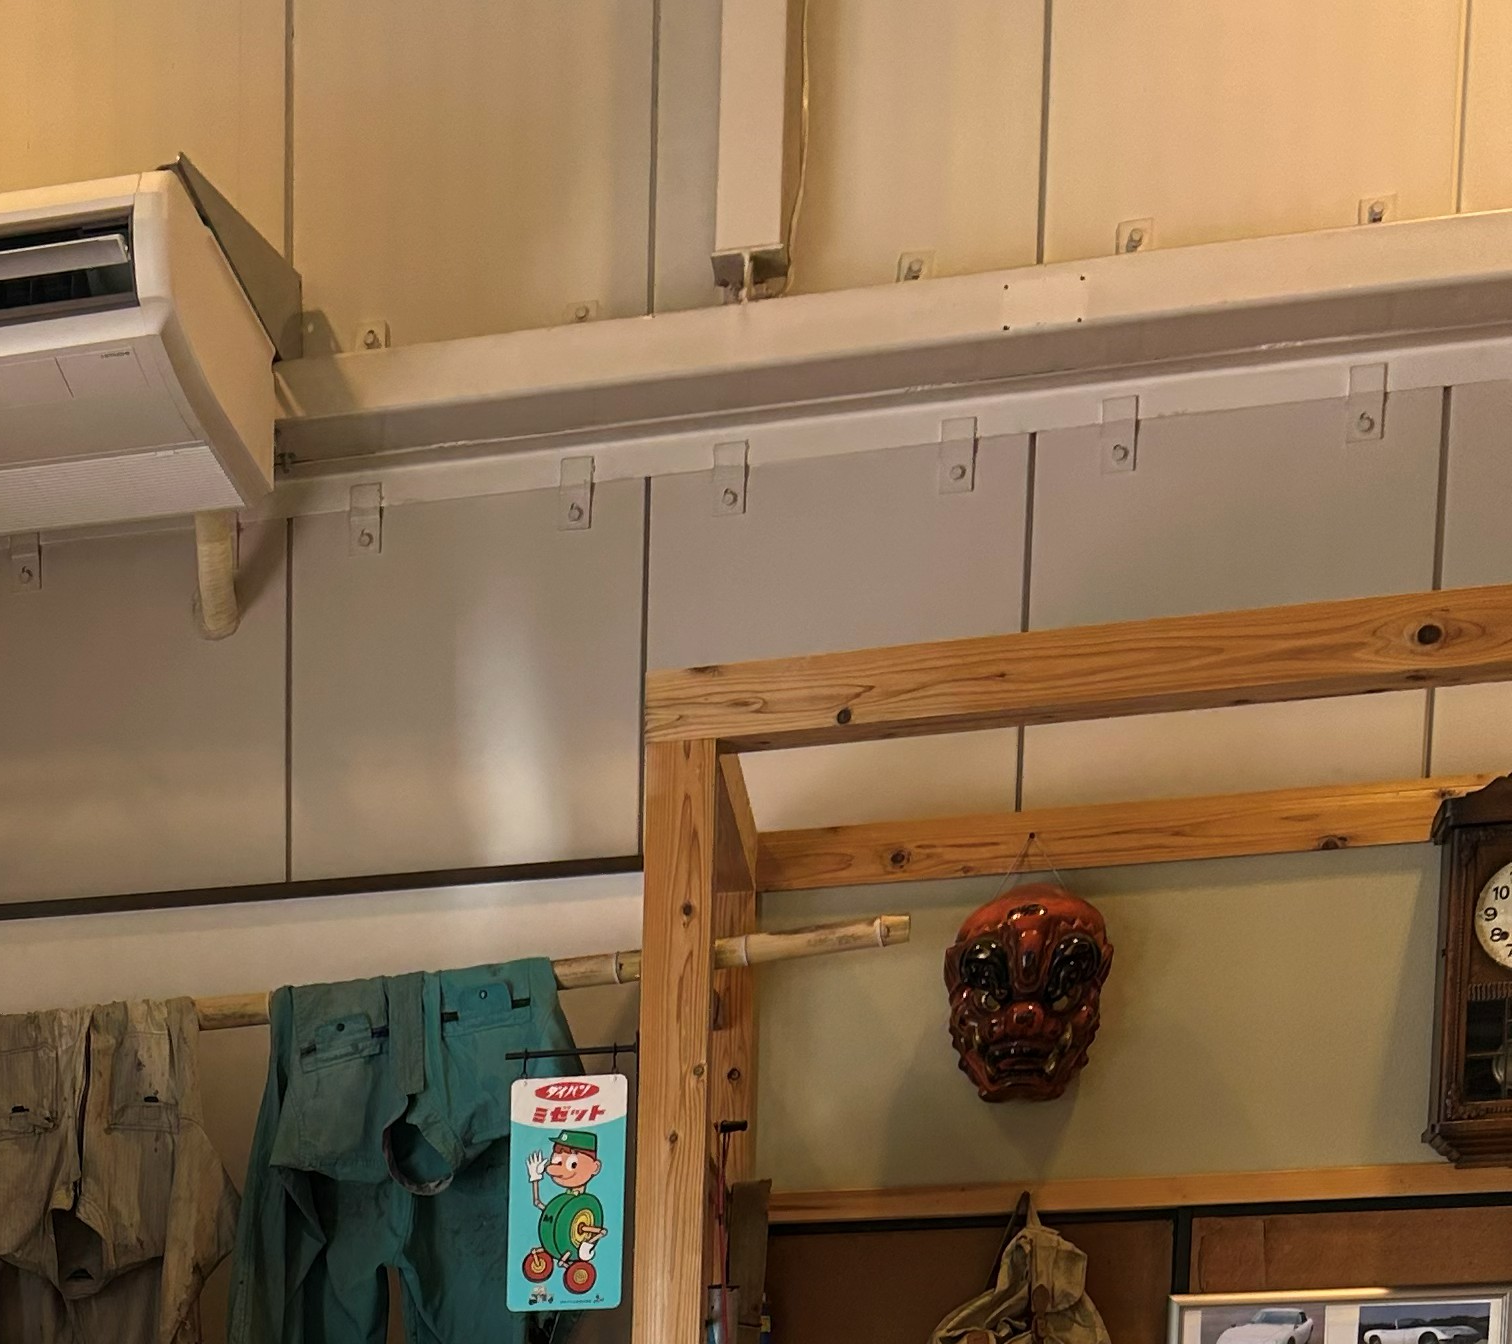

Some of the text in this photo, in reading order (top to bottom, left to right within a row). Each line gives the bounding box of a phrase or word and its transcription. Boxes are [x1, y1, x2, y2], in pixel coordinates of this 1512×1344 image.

[1493, 885, 1510, 901] 10
[1484, 906, 1497, 922] 9
[1490, 927, 1502, 942] 8
[545, 1081, 591, 1099] ダイハツ
[531, 1104, 607, 1124] ミゼット
